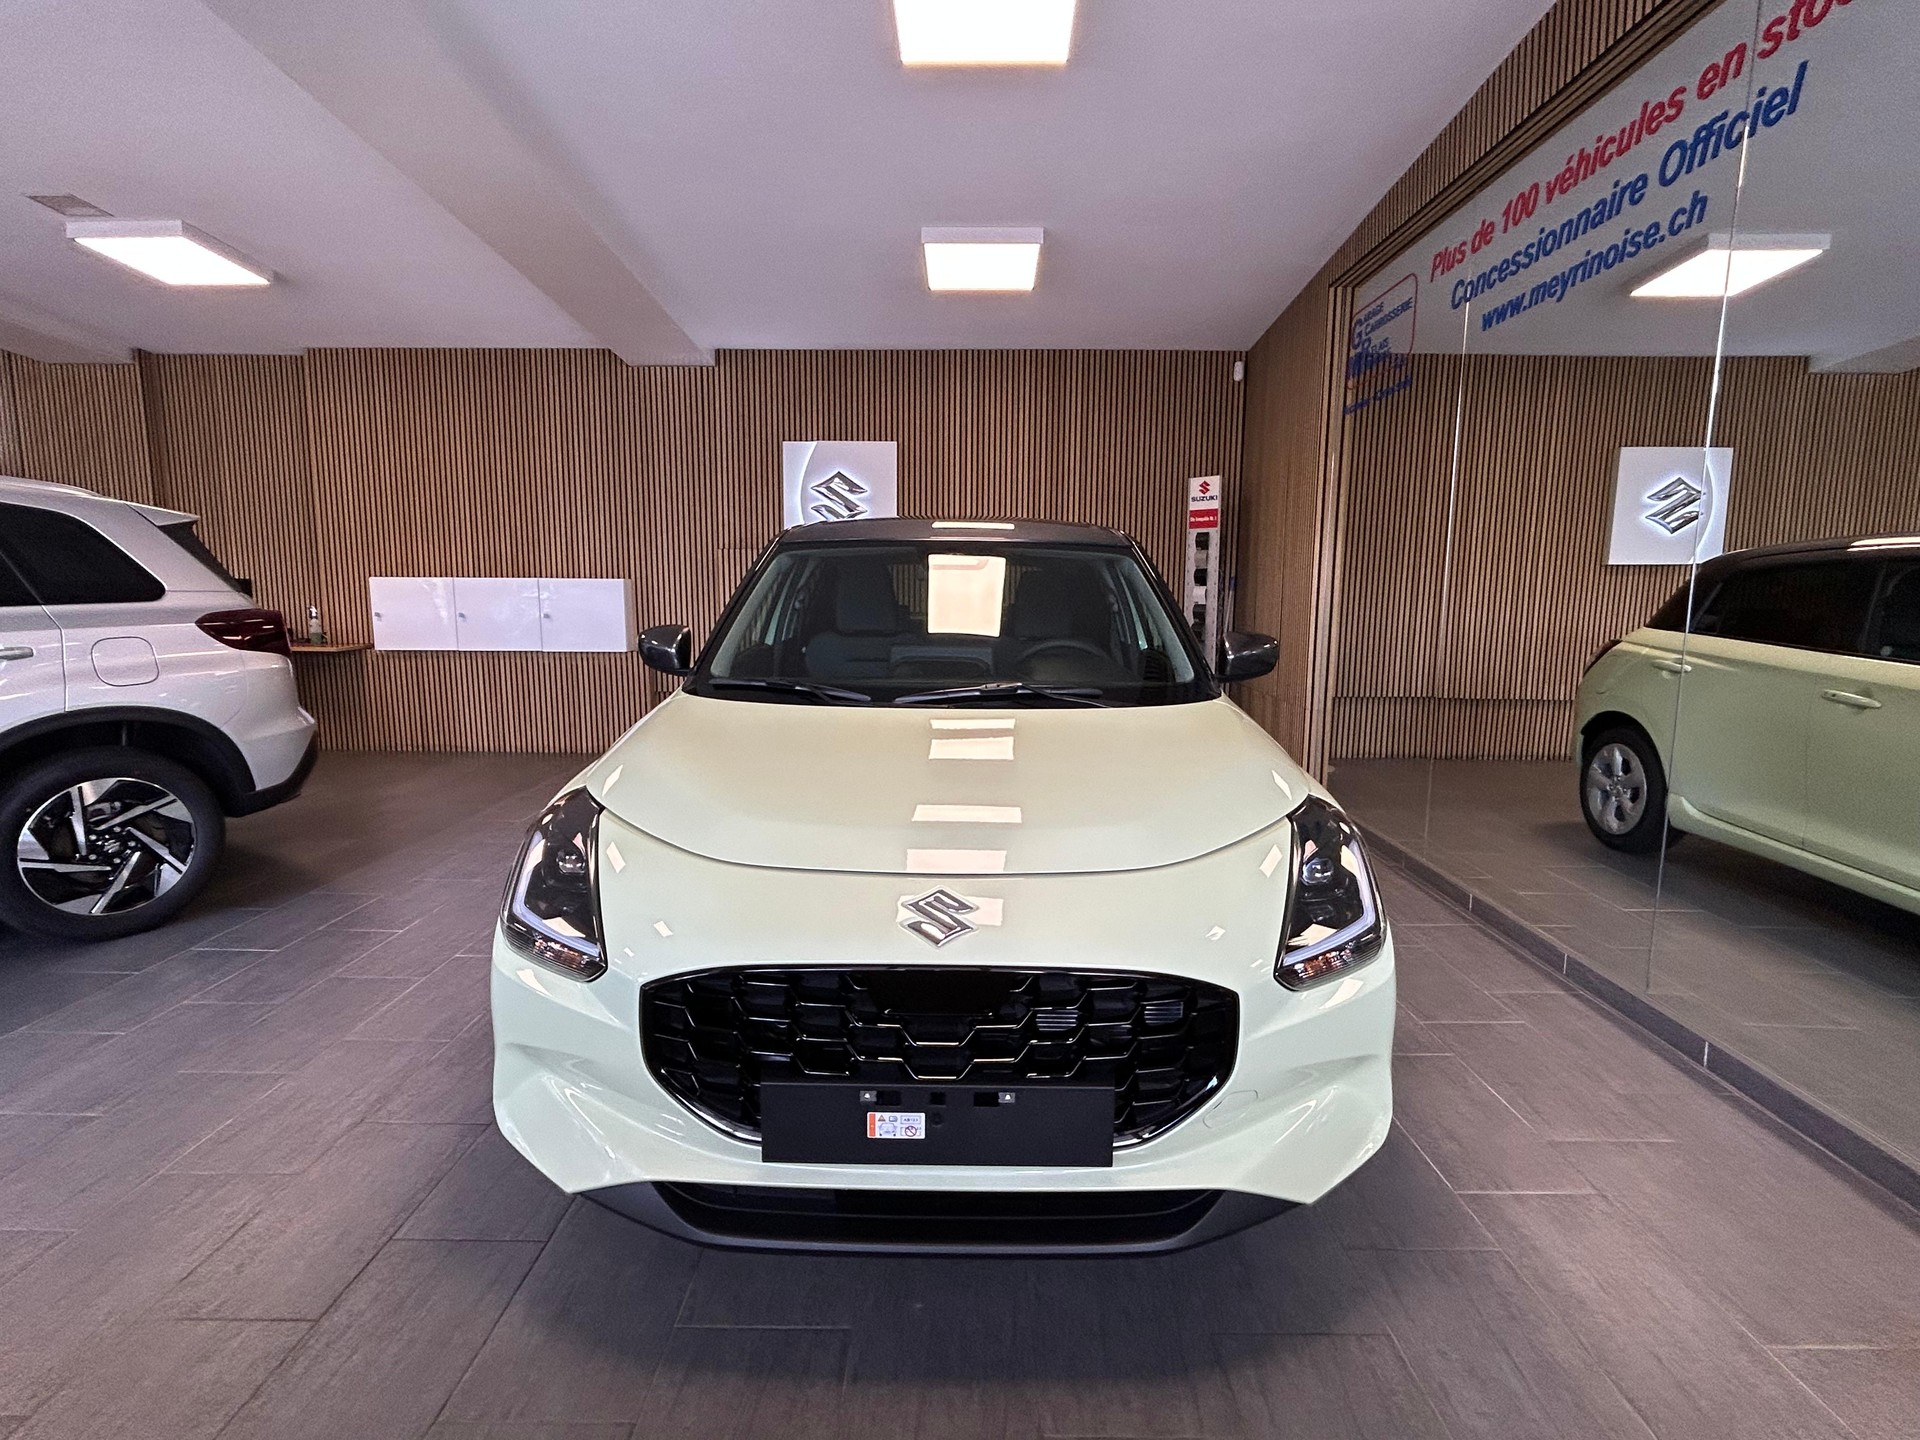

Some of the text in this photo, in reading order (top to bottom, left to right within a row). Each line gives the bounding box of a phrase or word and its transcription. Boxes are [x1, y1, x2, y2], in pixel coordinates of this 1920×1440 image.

[1430, 0, 1852, 283] Plus de 100 véhicules en sto
[1450, 59, 1810, 310] Concessionnaire Officiel
[1481, 189, 1709, 332] www.meyrinoise.ch
